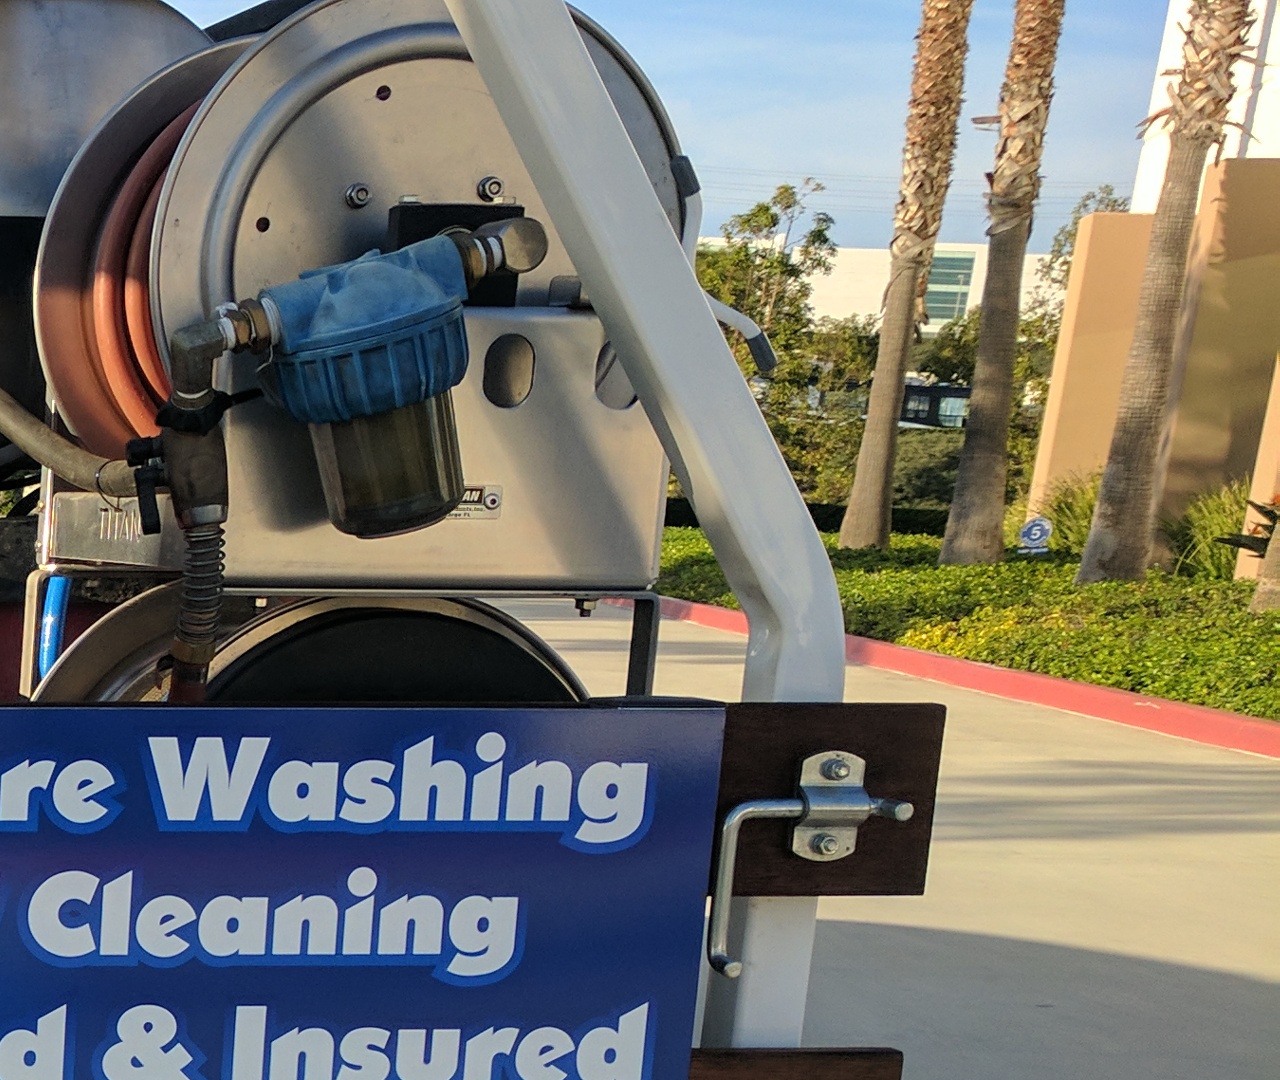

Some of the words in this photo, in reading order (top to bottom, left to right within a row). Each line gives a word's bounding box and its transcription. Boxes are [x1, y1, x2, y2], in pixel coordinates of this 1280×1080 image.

[99, 507, 142, 542] TITAN
[1030, 526, 1041, 539] 5
[148, 732, 649, 844] Washing
[26, 866, 520, 977] Cleaning
